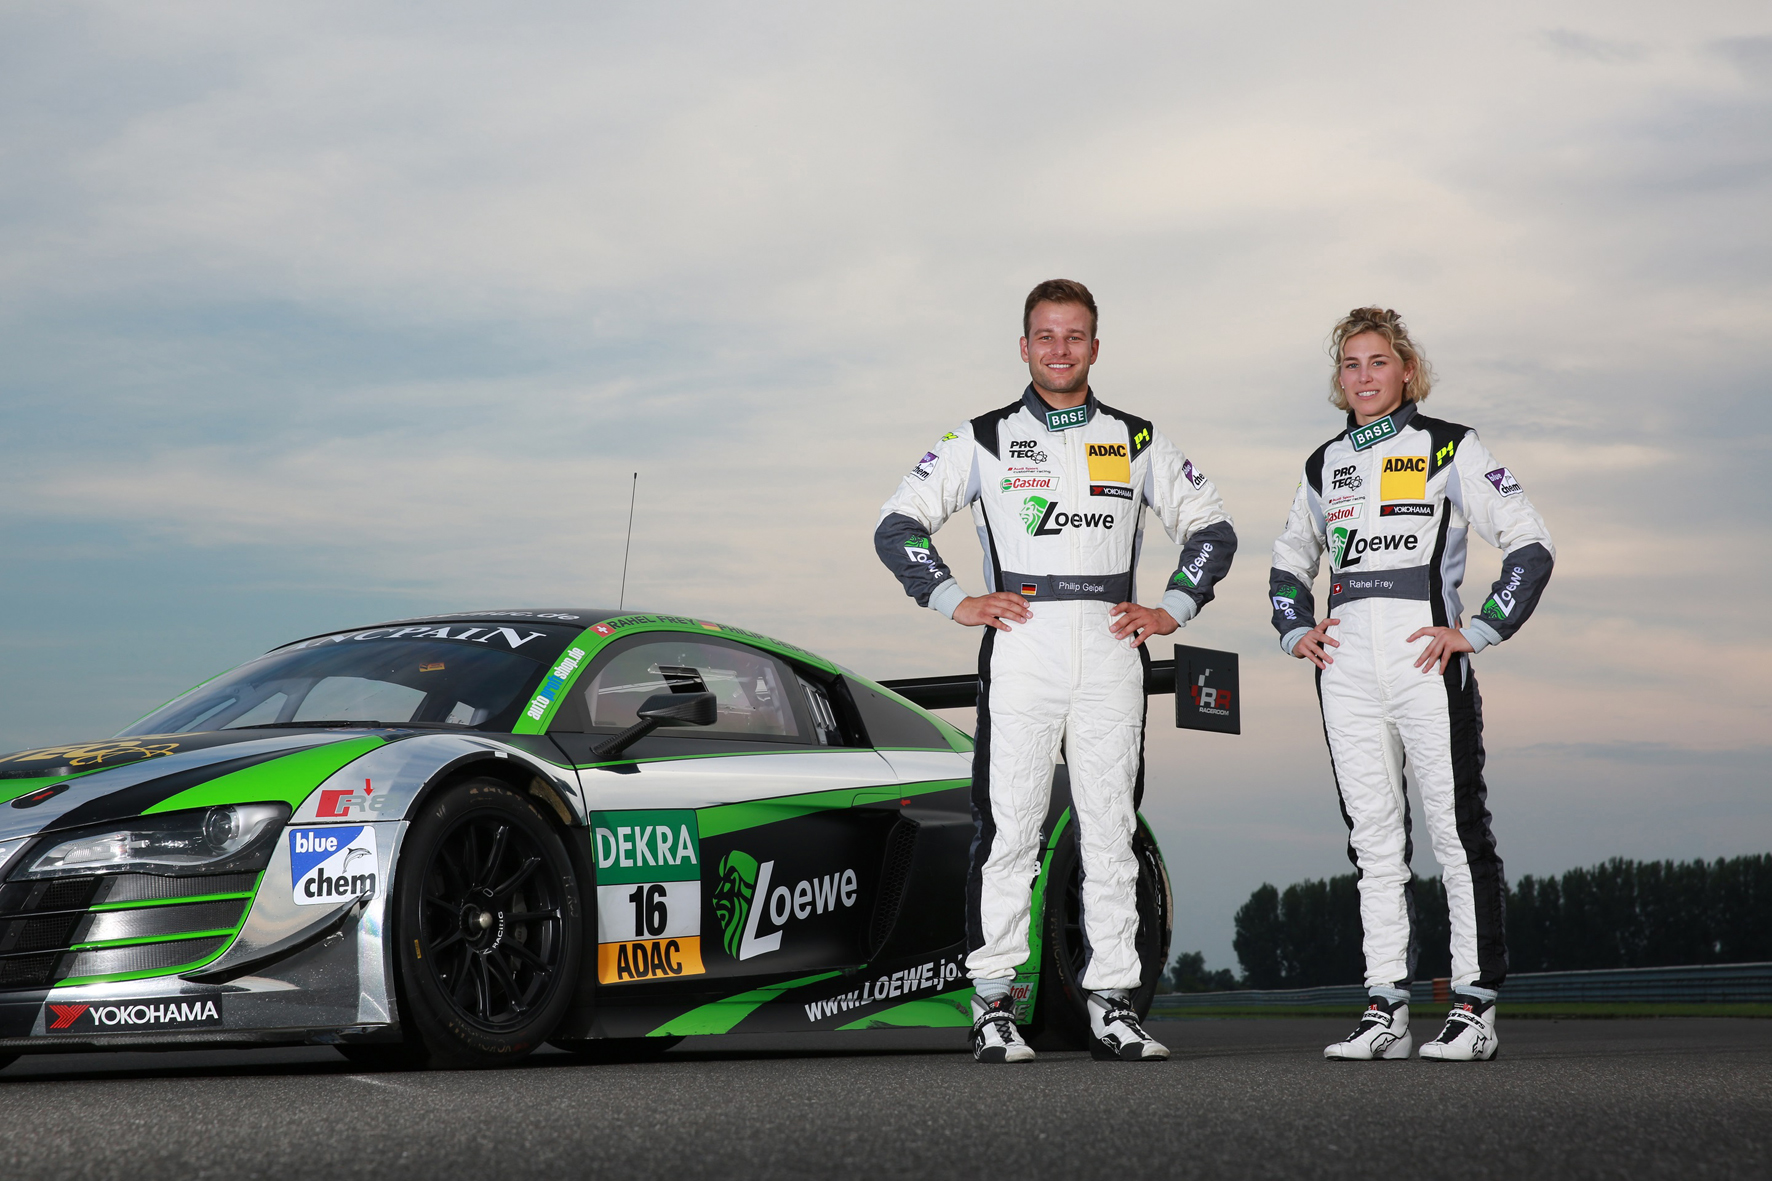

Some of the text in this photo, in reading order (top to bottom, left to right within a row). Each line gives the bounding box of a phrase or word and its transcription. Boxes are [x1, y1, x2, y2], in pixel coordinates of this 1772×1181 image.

[1051, 411, 1085, 426] BASE
[1356, 422, 1392, 445] BASE
[1010, 441, 1037, 449] PRO
[1088, 445, 1127, 457] ADAC
[1009, 450, 1034, 459] TEC
[1333, 465, 1356, 480] PRO
[1383, 458, 1426, 473] ADAC
[1012, 477, 1051, 489] Castrol
[1331, 478, 1352, 491] TEC
[1103, 487, 1132, 498] YOKOHAMA
[1393, 506, 1431, 514] YOKOHAMA
[1033, 501, 1115, 537] Loewe
[1340, 528, 1418, 569] Loewe
[1181, 542, 1213, 586] Loewe
[1058, 581, 1105, 593] Philip Geipel
[1349, 579, 1394, 590] Rahel Frey
[1492, 566, 1525, 617] Loewe
[606, 615, 657, 630] RAHEL
[656, 615, 697, 626] FREY
[1199, 706, 1230, 716] RACEROOM
[295, 833, 338, 853] blue
[595, 824, 697, 868] DEKRA
[304, 868, 376, 898] chem
[629, 884, 668, 937] 16
[739, 860, 858, 961] Loewe
[616, 940, 683, 980] ADAC
[1010, 985, 1029, 999] trol
[89, 1001, 219, 1026] YOKOHAMA
